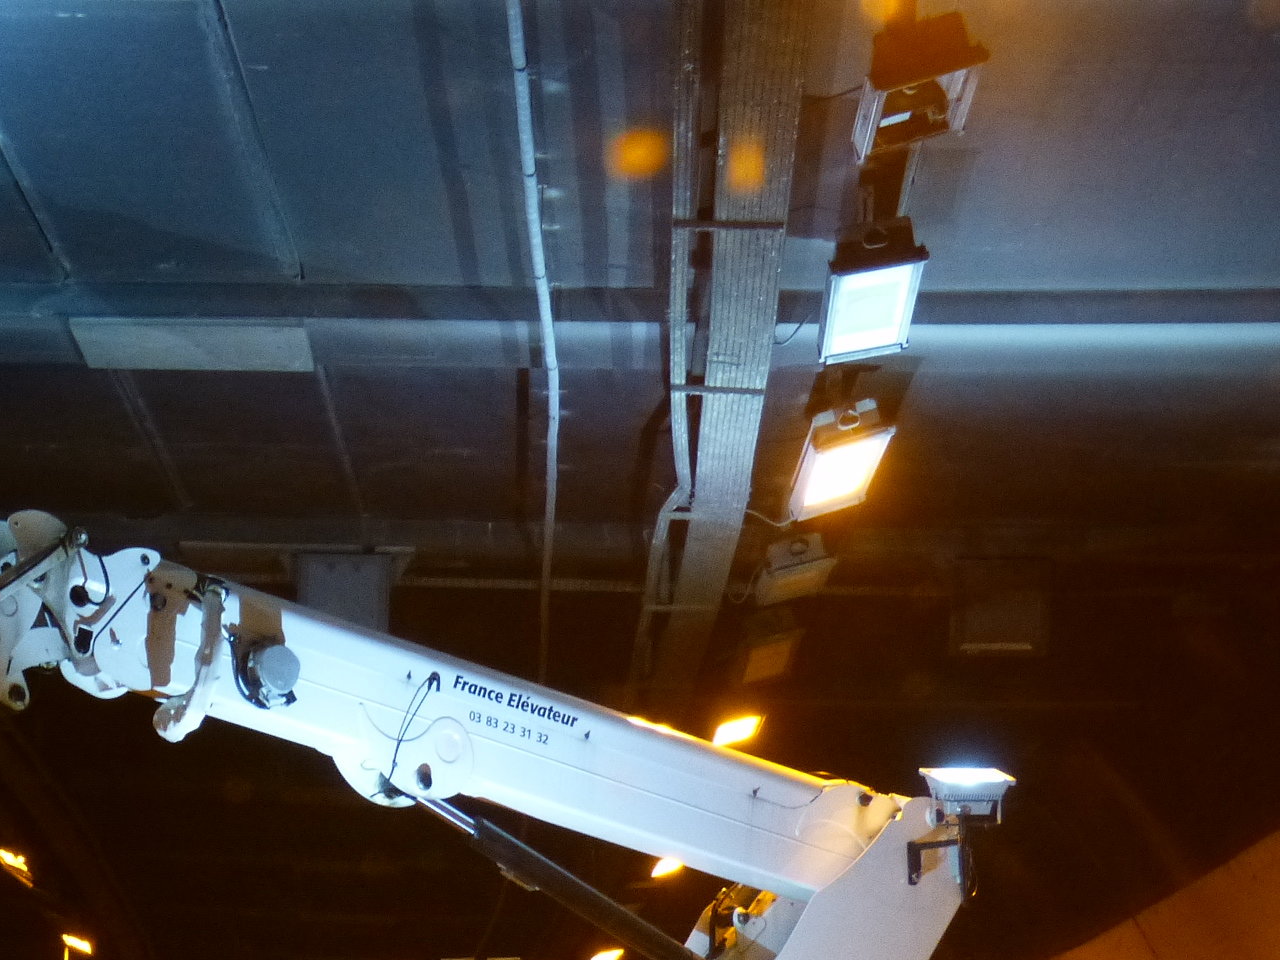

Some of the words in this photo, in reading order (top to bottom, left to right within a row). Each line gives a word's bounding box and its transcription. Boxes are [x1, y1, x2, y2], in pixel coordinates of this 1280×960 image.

[452, 674, 504, 704] France
[507, 692, 579, 728] Elévateur
[468, 710, 481, 723] 03
[485, 716, 499, 729] 83
[502, 721, 516, 734] 23
[520, 726, 532, 740] 31
[536, 732, 549, 745] 32
